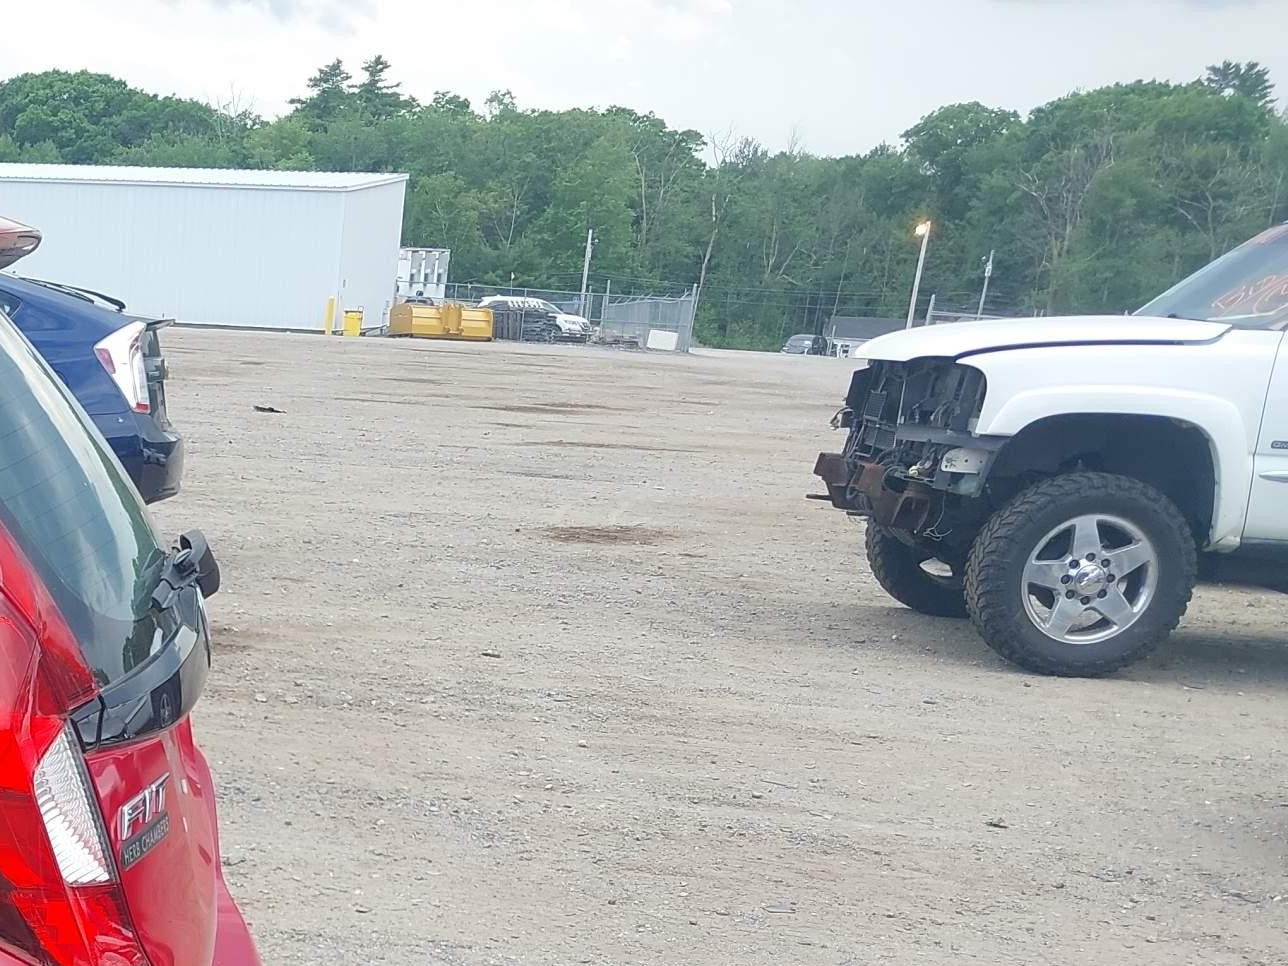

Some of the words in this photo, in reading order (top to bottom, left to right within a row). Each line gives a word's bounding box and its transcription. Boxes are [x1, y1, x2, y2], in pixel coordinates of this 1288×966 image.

[120, 771, 170, 841] FIT
[123, 841, 141, 865] HERB
[141, 816, 169, 852] CHAMBERS
